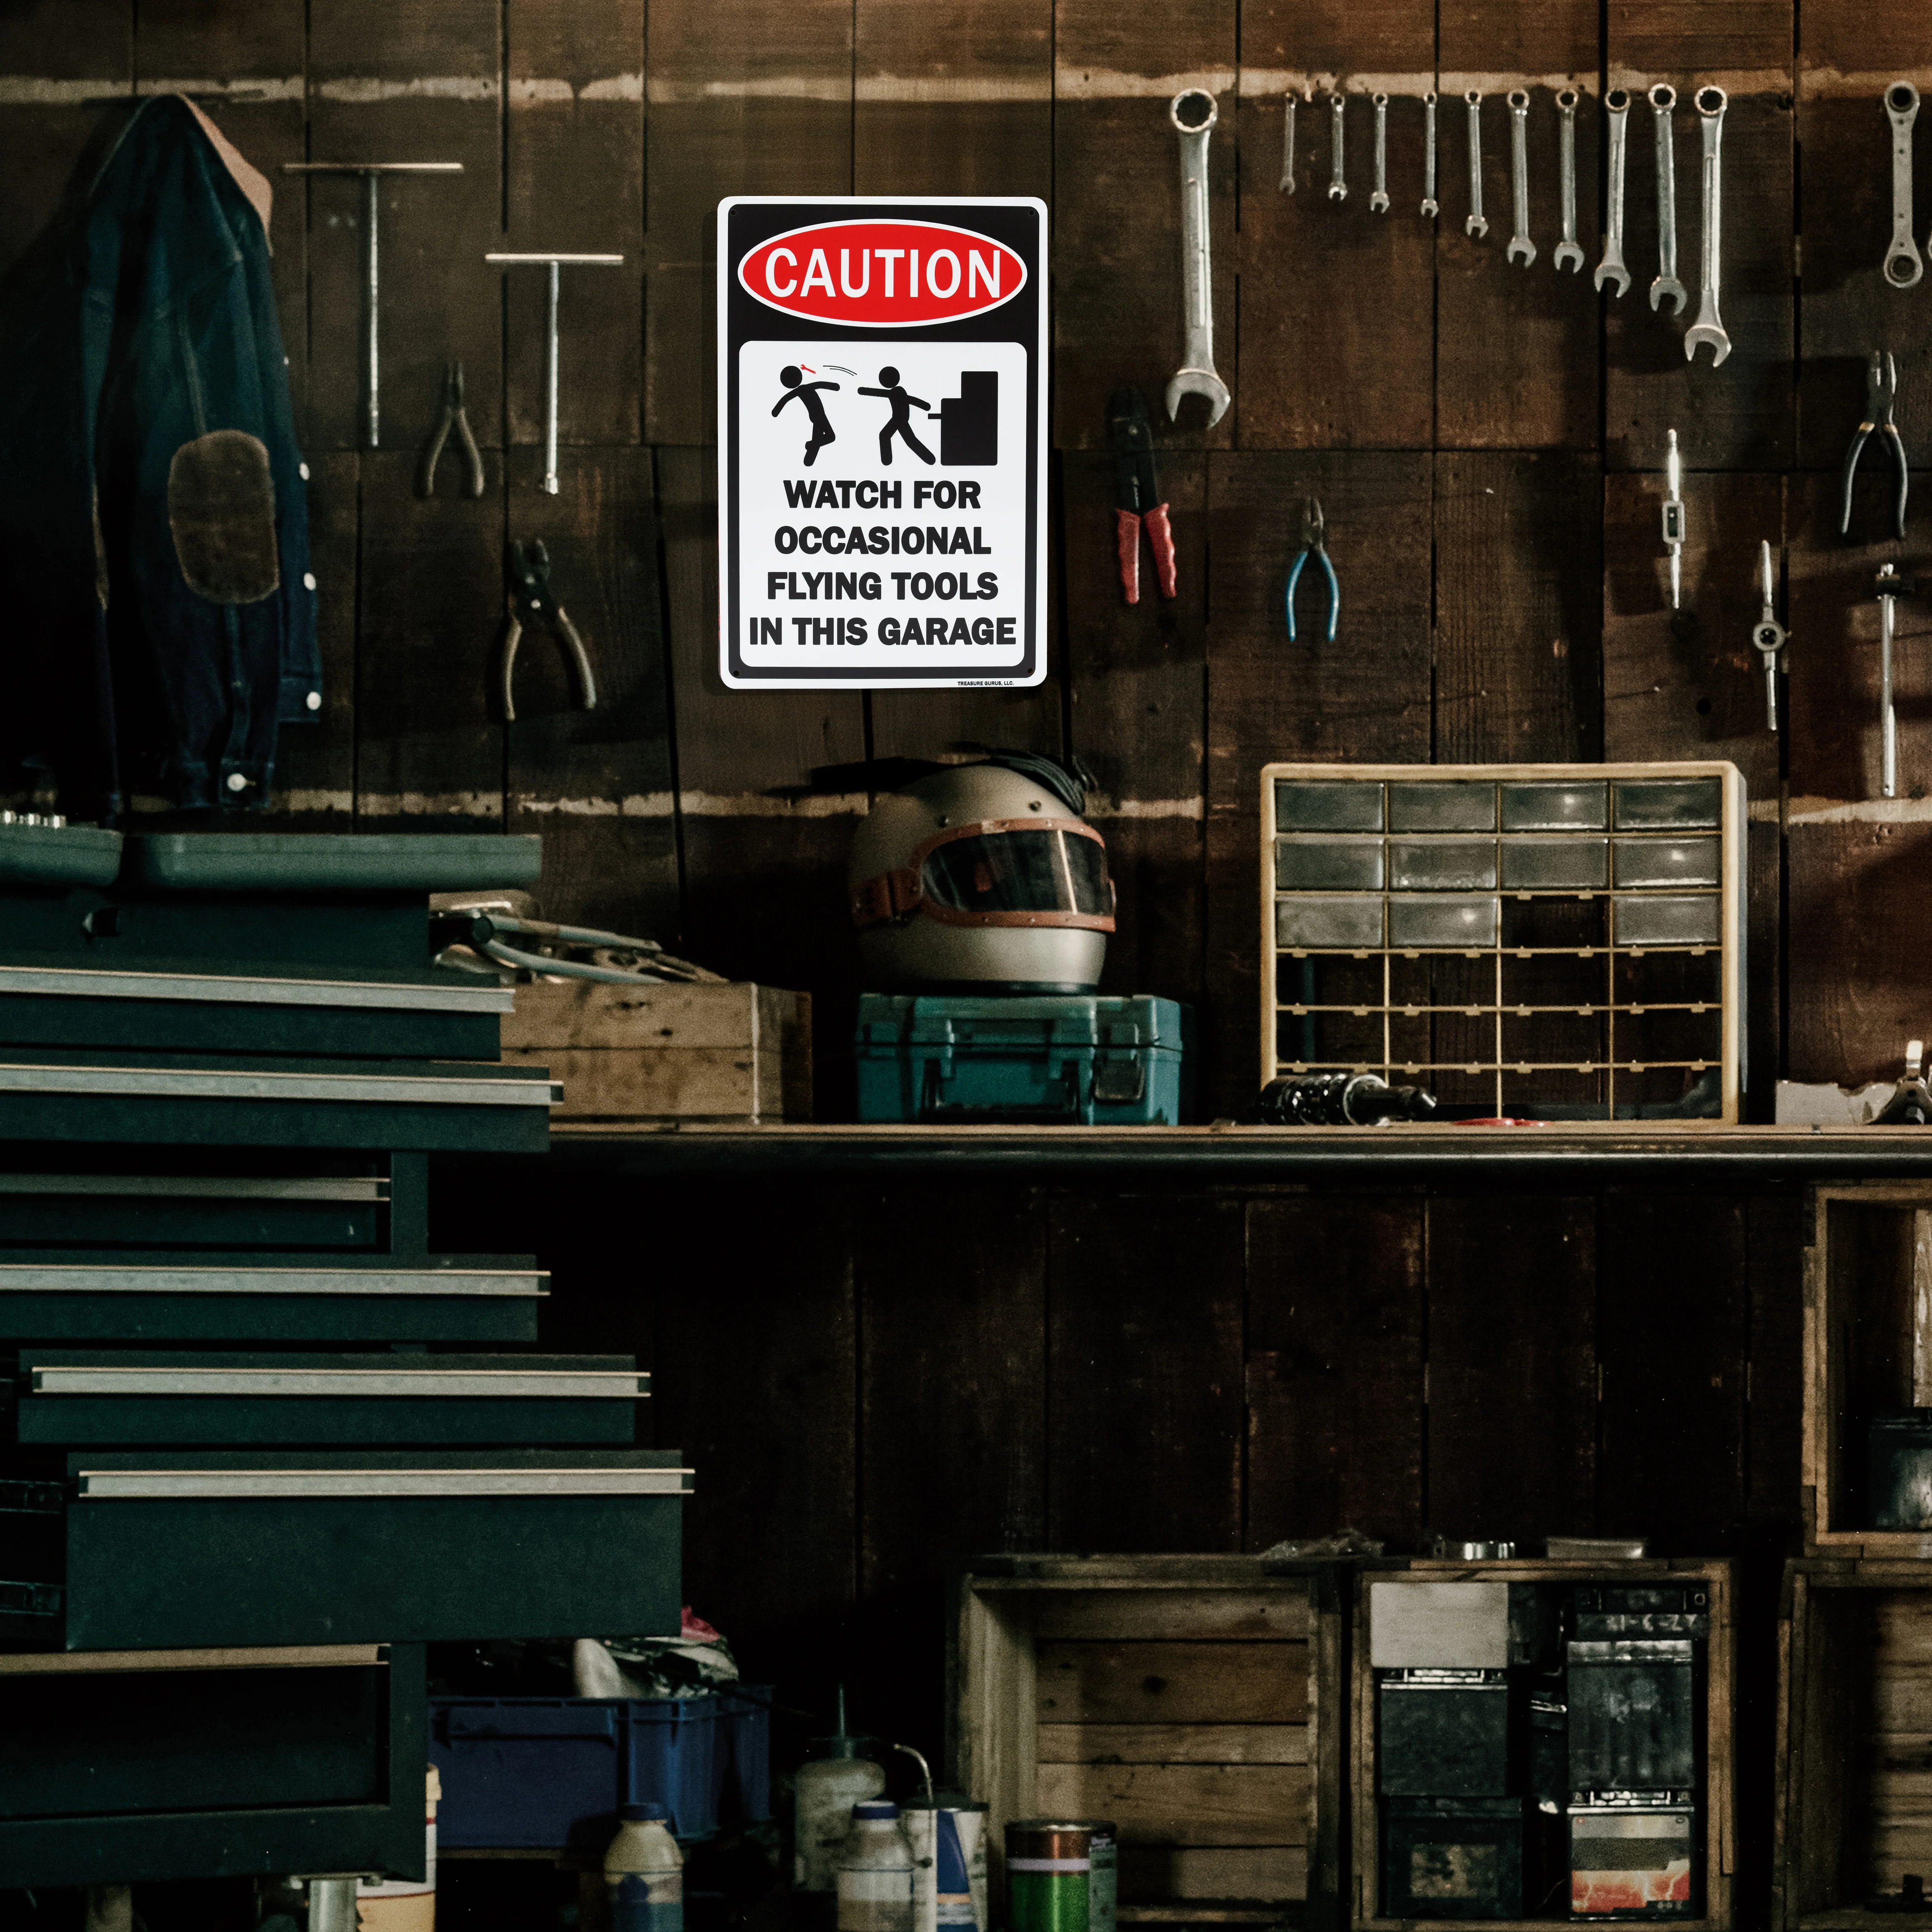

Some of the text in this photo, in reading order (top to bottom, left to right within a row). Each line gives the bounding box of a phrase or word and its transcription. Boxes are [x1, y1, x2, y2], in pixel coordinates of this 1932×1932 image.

[765, 248, 1000, 299] CAUTION
[783, 480, 981, 509] WATCH FOR
[774, 525, 991, 555] OCCASIONAL
[767, 572, 998, 600] FLYING TOOLS
[749, 617, 1016, 646] IN THIS GARAGE
